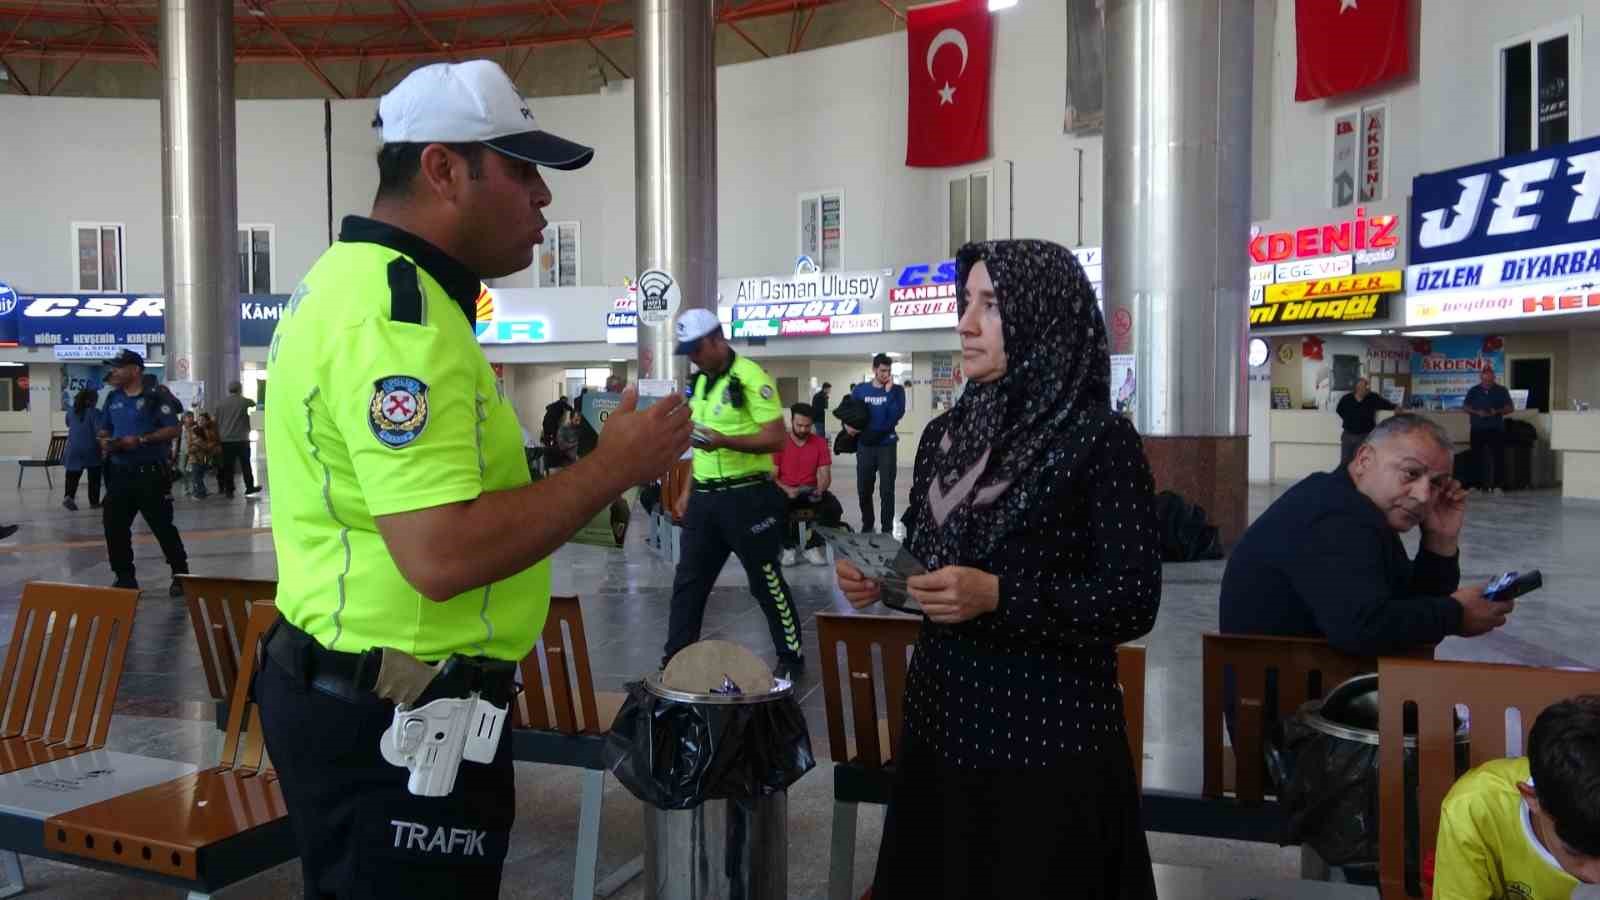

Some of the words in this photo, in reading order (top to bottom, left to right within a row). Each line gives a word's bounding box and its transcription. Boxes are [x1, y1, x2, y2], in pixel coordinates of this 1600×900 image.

[1419, 150, 1600, 249] JET
[736, 280, 756, 300] Ali
[761, 279, 817, 300] Osman
[822, 275, 880, 299] Ulusoy
[1416, 264, 1483, 292] ÖZLEM
[23, 298, 165, 317] CSR
